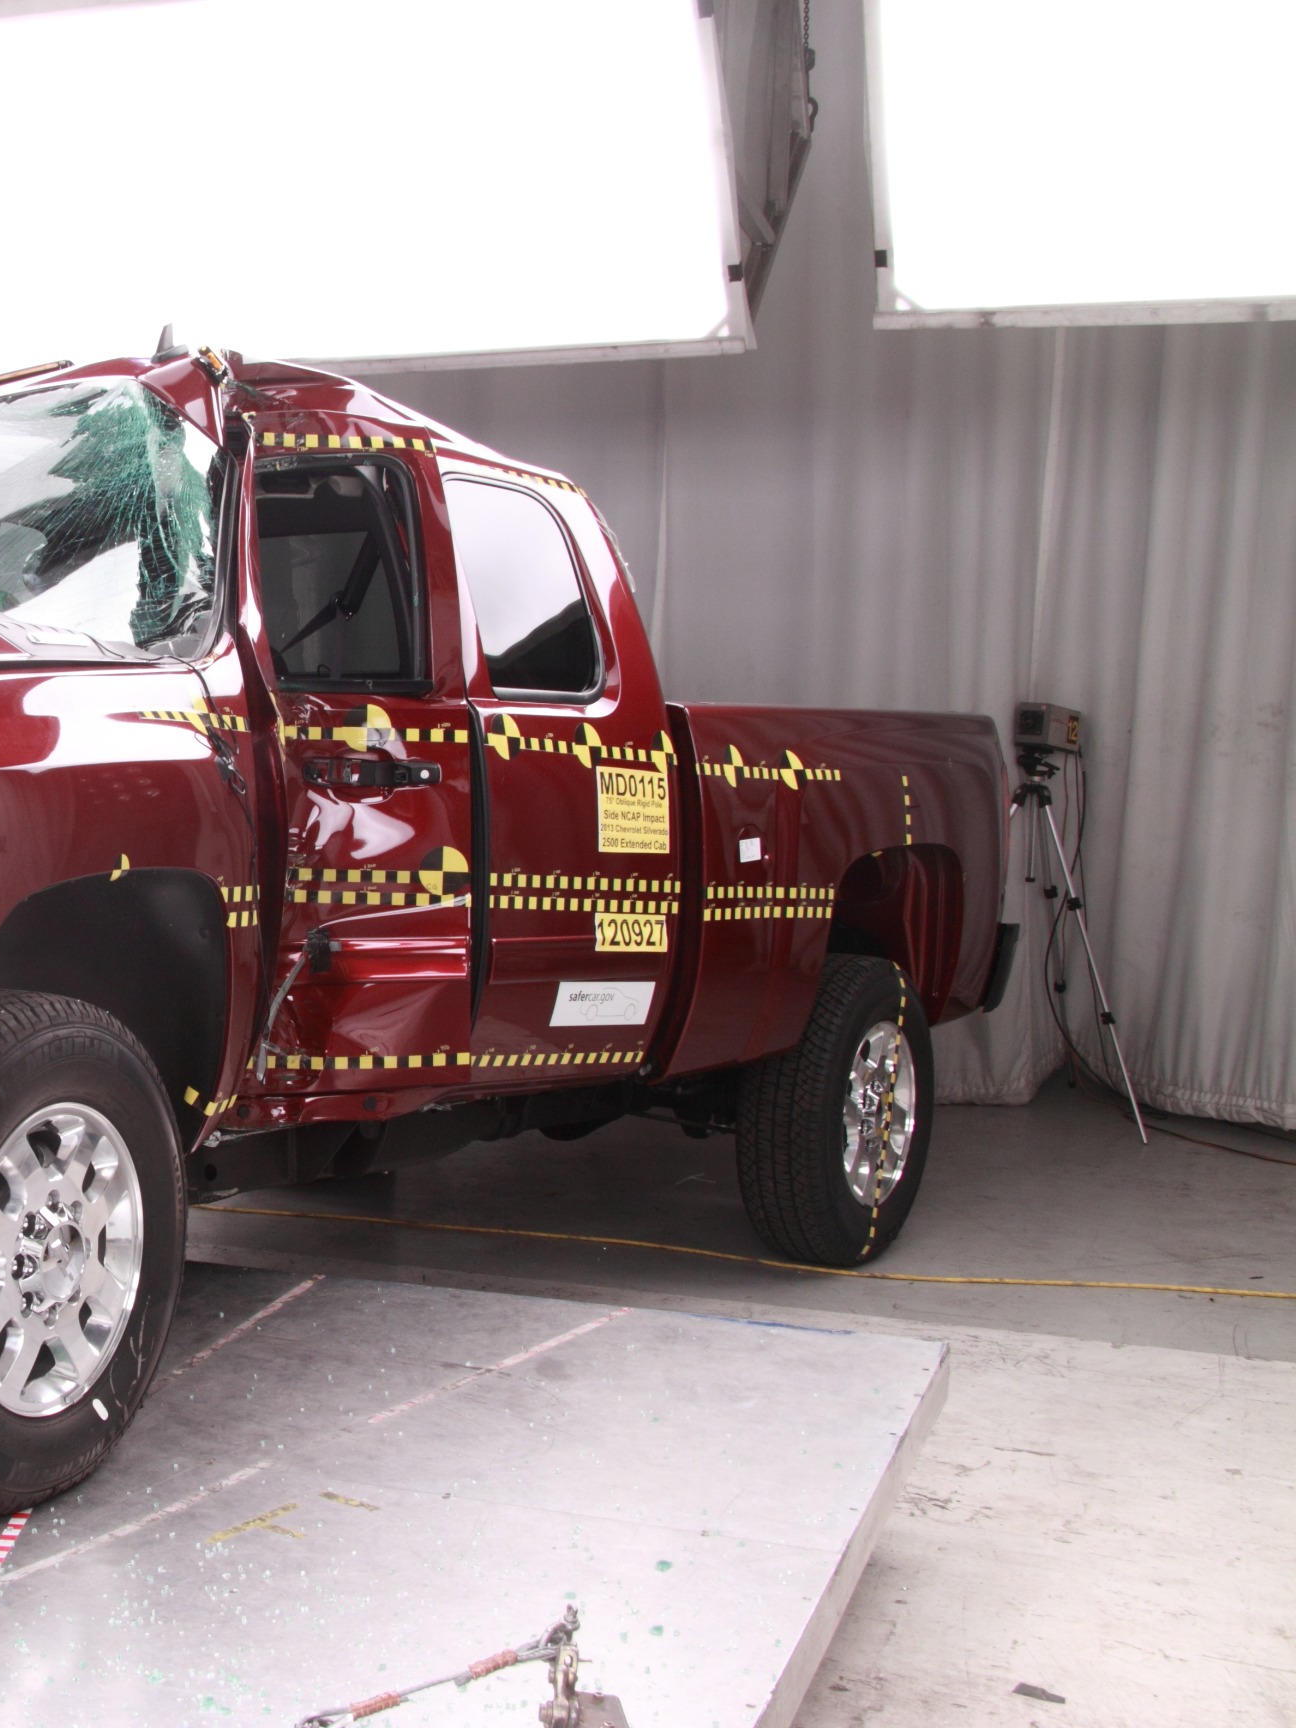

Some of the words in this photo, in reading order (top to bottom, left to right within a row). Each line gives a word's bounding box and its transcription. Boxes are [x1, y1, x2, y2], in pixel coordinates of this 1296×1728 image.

[1068, 720, 1079, 741] 12
[600, 772, 666, 800] MD0115
[616, 797, 636, 807] Oblique
[637, 799, 650, 809] Rigid
[651, 800, 662, 808] Pole
[604, 809, 619, 820] Side
[621, 811, 641, 822] NCAP
[643, 813, 665, 825] Impact
[615, 824, 642, 834] Chevrolet
[643, 826, 668, 836] Silverado
[602, 837, 619, 848] 2500
[620, 839, 652, 850] Extended
[653, 840, 667, 851] Cab
[597, 918, 665, 947] 120927
[568, 989, 615, 1004] safercar.gov
